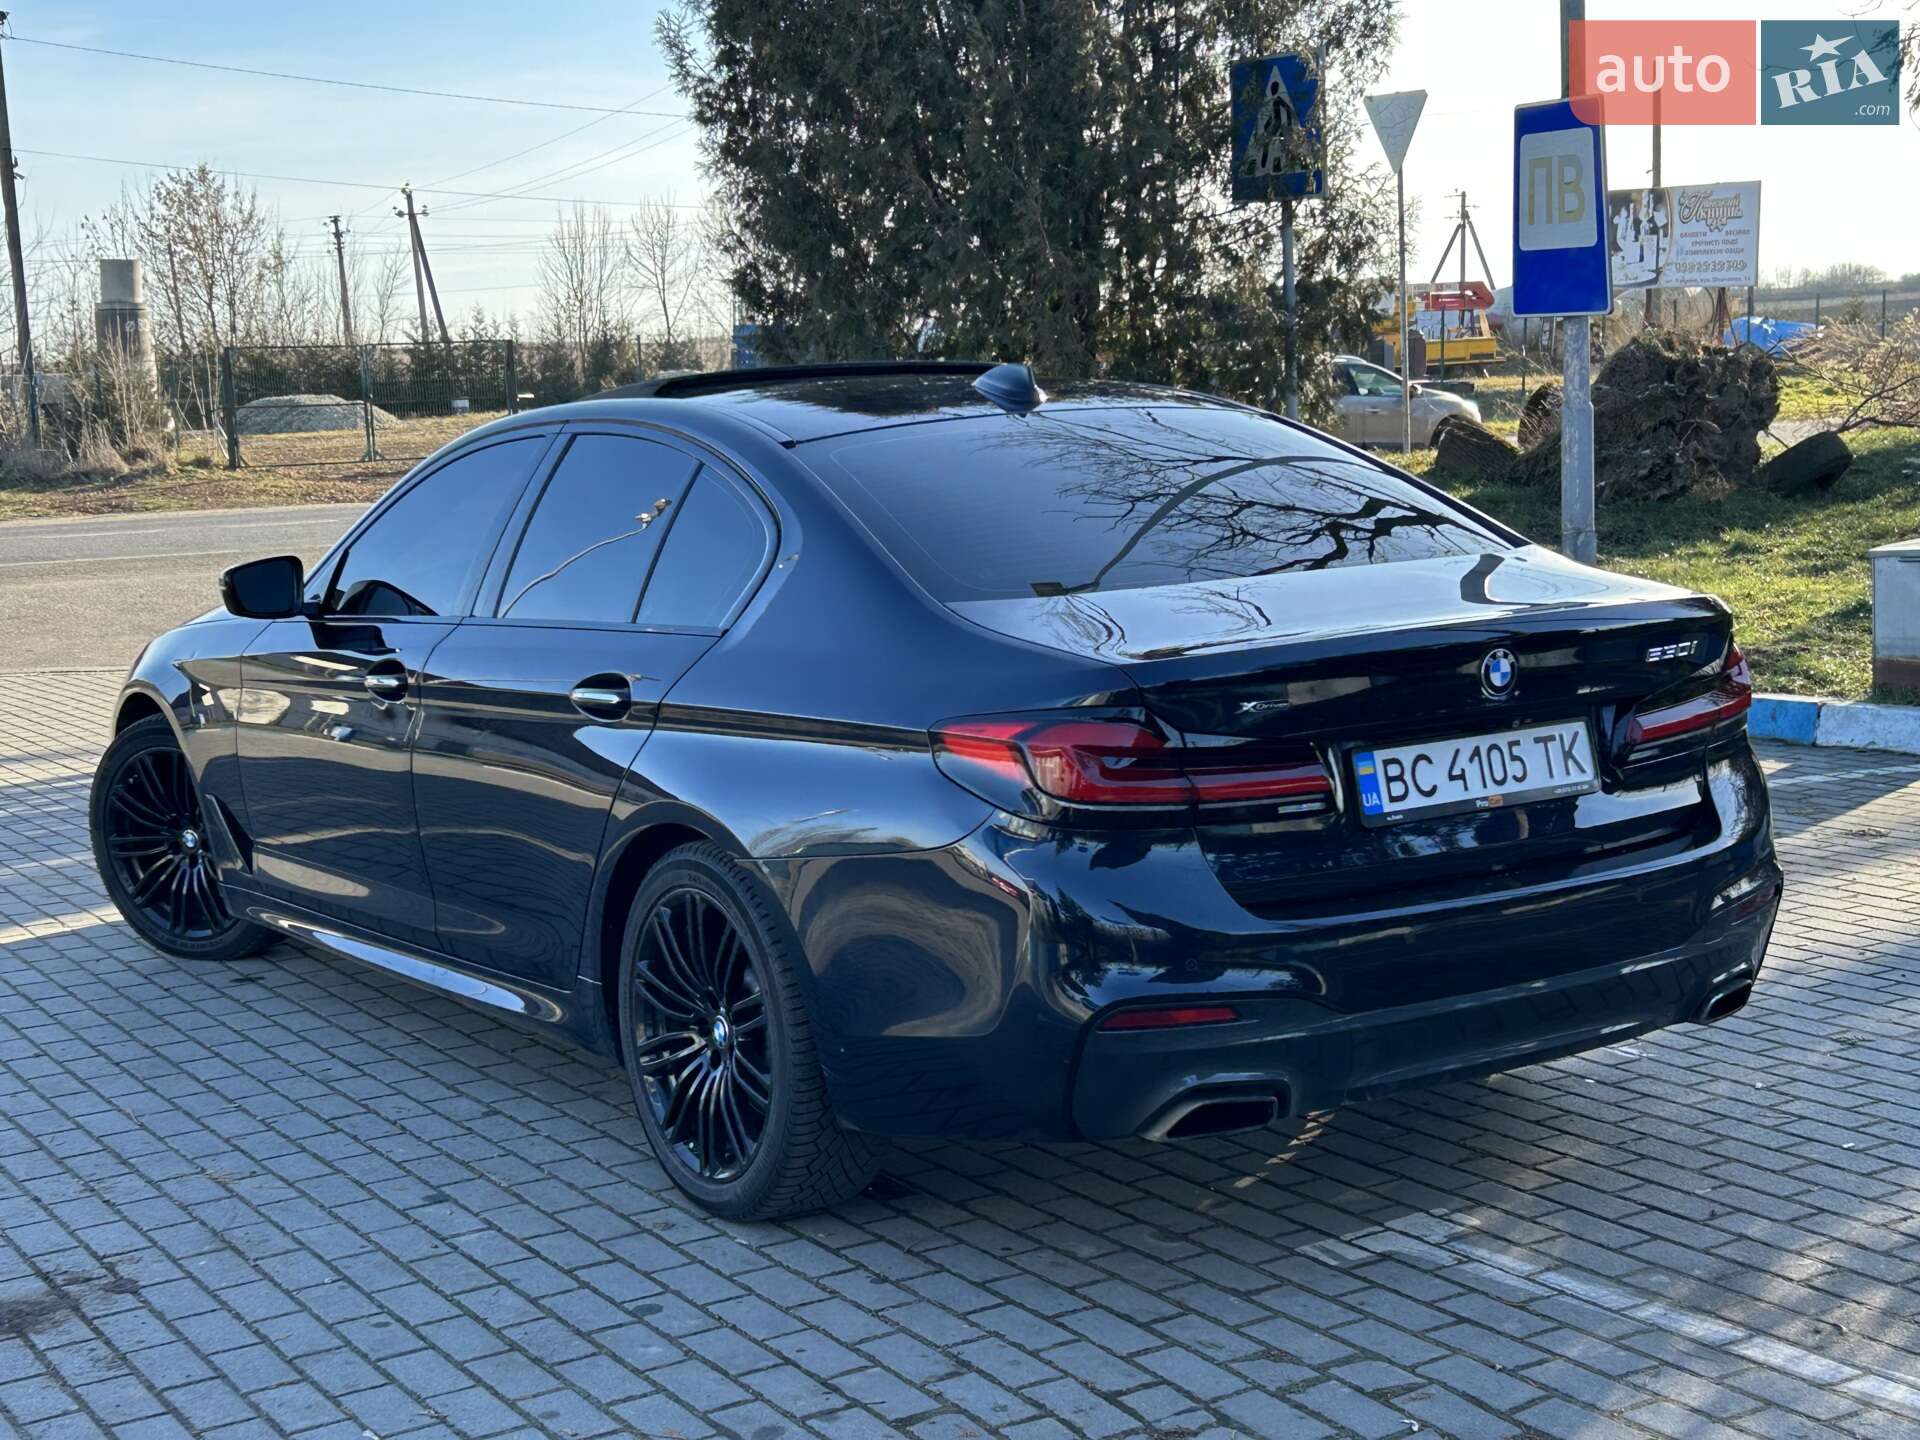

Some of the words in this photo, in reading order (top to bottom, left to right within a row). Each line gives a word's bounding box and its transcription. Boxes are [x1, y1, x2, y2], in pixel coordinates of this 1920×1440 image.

[1528, 154, 1585, 225] ПВ
[1362, 792, 1381, 807] UA
[1382, 754, 1437, 803] BC
[1448, 740, 1528, 791] 4105
[1533, 731, 1587, 779] TK
